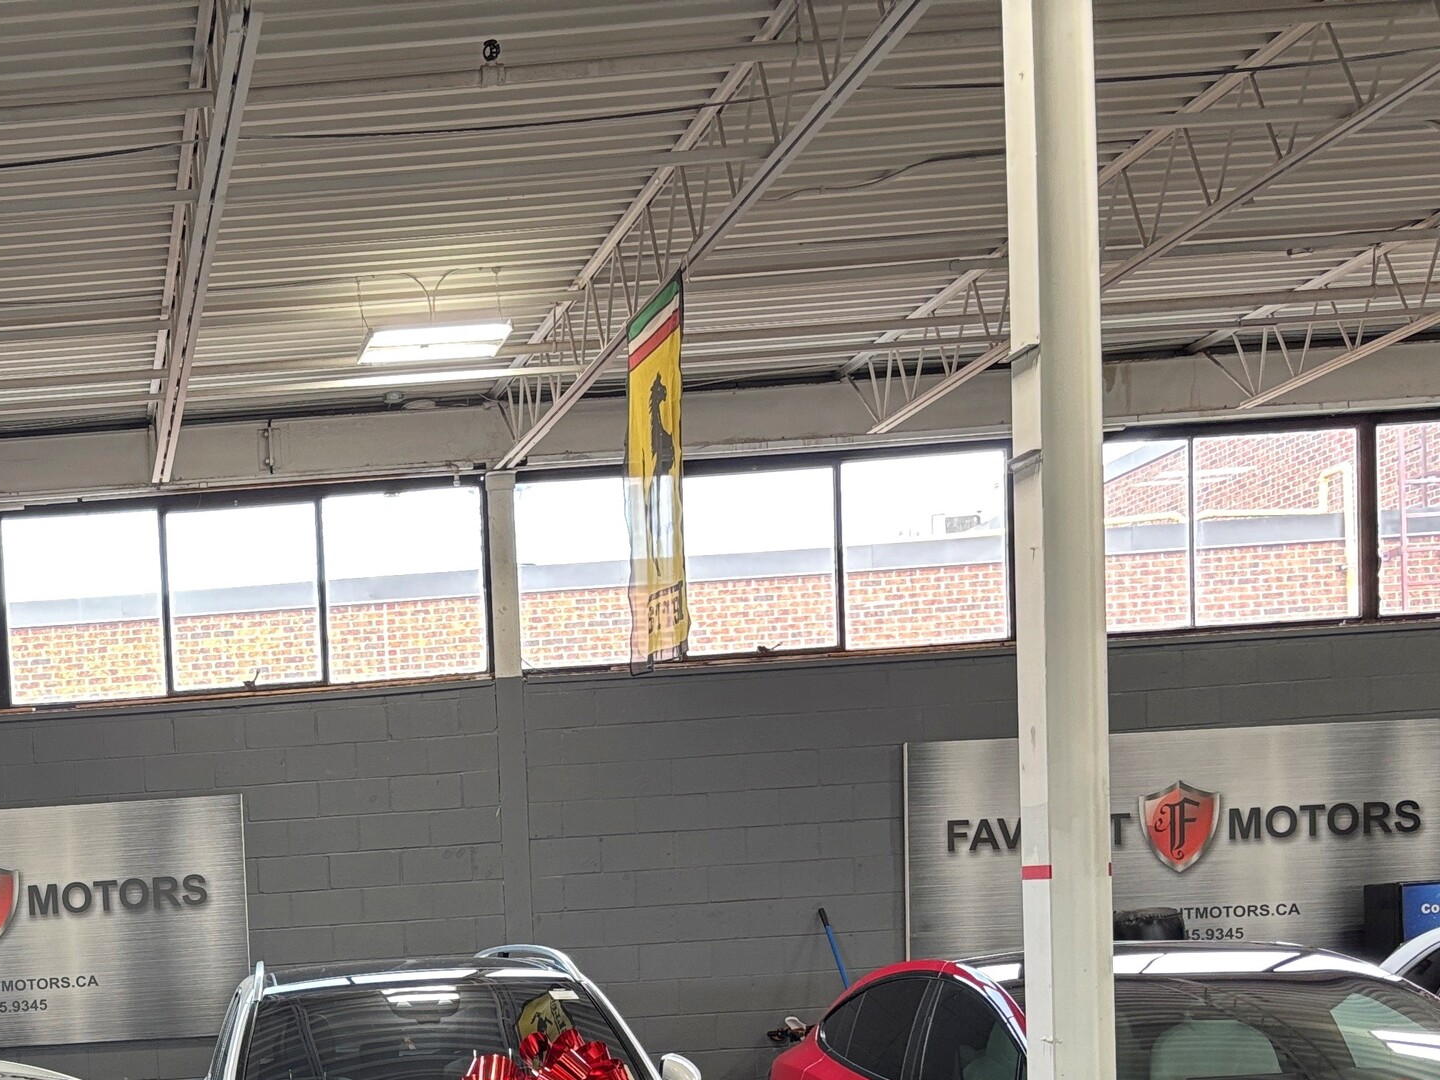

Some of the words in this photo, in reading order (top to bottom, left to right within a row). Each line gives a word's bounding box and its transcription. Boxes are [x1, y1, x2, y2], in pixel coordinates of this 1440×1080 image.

[947, 813, 1131, 851] FAVT
[1228, 800, 1422, 840] MOTORS
[27, 874, 208, 916] MOTORS
